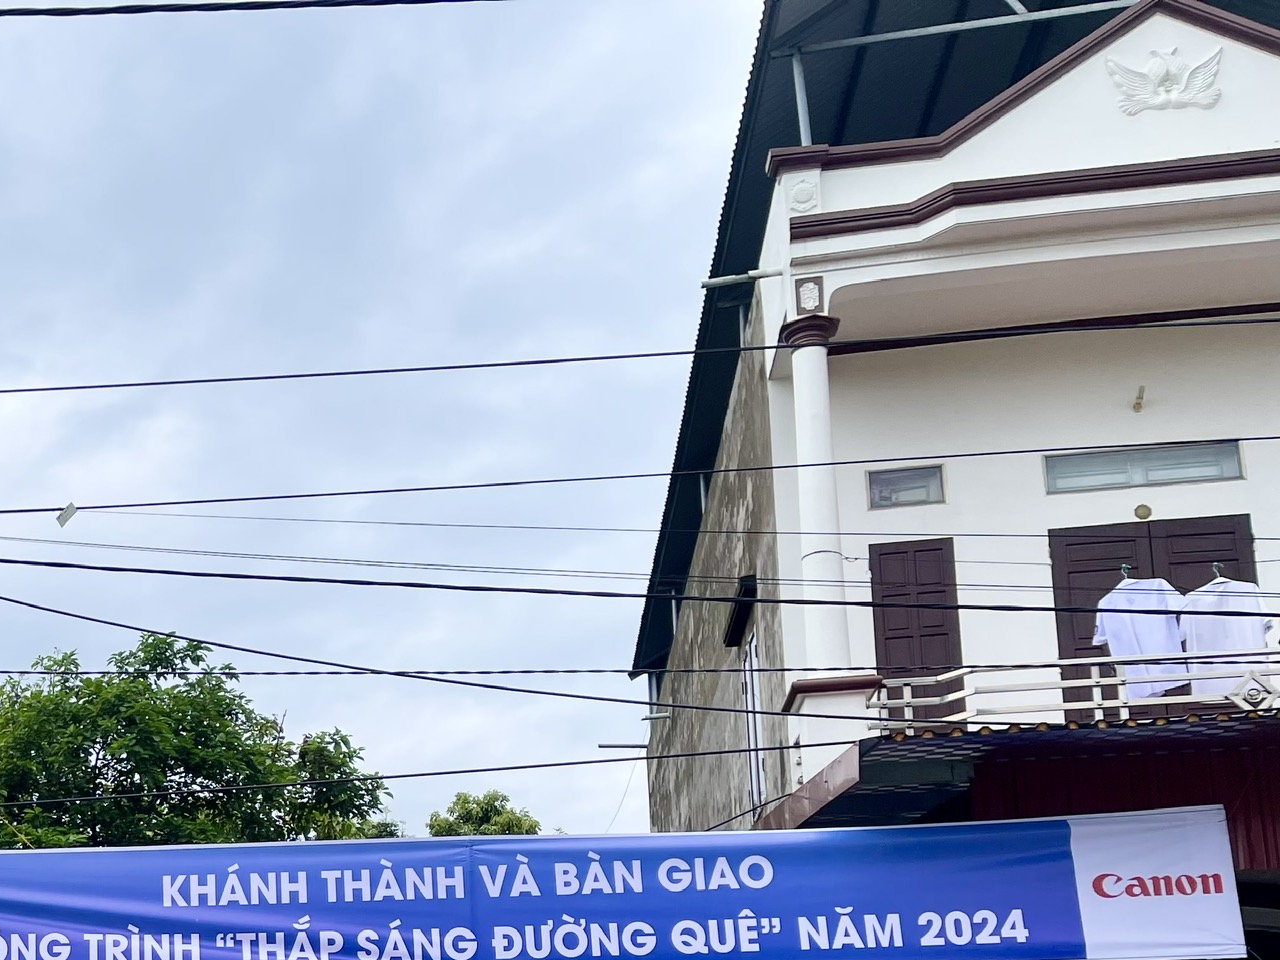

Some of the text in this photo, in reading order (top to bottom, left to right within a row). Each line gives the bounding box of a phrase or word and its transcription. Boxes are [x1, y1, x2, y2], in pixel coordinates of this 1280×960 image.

[162, 850, 774, 907] KHÁNH THÀNH VÀ BÀN GIAO
[1092, 873, 1224, 898] Canon
[491, 913, 657, 960] ĐƯỜNG
[797, 907, 904, 950] NĂM
[918, 909, 1029, 946] 2024
